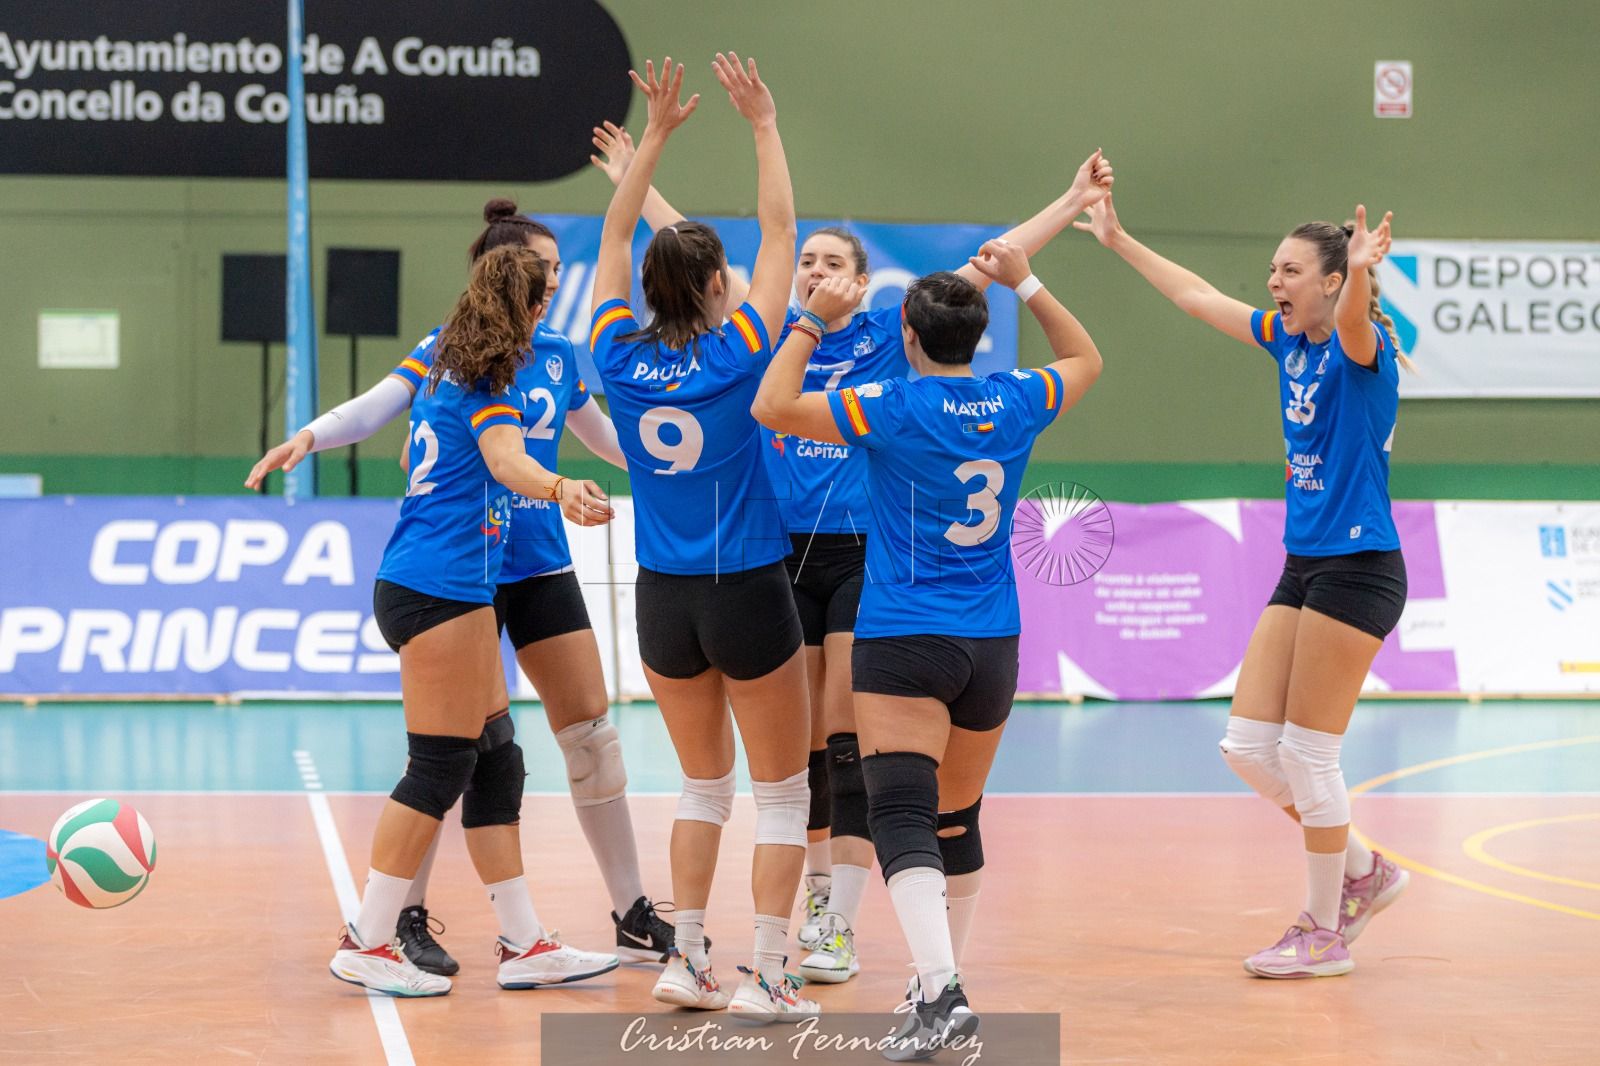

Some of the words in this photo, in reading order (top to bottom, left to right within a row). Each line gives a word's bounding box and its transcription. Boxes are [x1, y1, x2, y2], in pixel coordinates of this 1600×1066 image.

[301, 33, 344, 75] de
[352, 36, 388, 75] A
[393, 37, 541, 77] Coruña
[171, 81, 225, 122] da
[234, 84, 385, 124] Couña
[1434, 301, 1600, 334] GALEG
[632, 355, 702, 382] PAULA
[406, 419, 439, 497] 2
[638, 406, 704, 476] 9
[796, 444, 850, 459] CAPITAL
[943, 458, 1005, 547] 3
[89, 519, 355, 586] COPA
